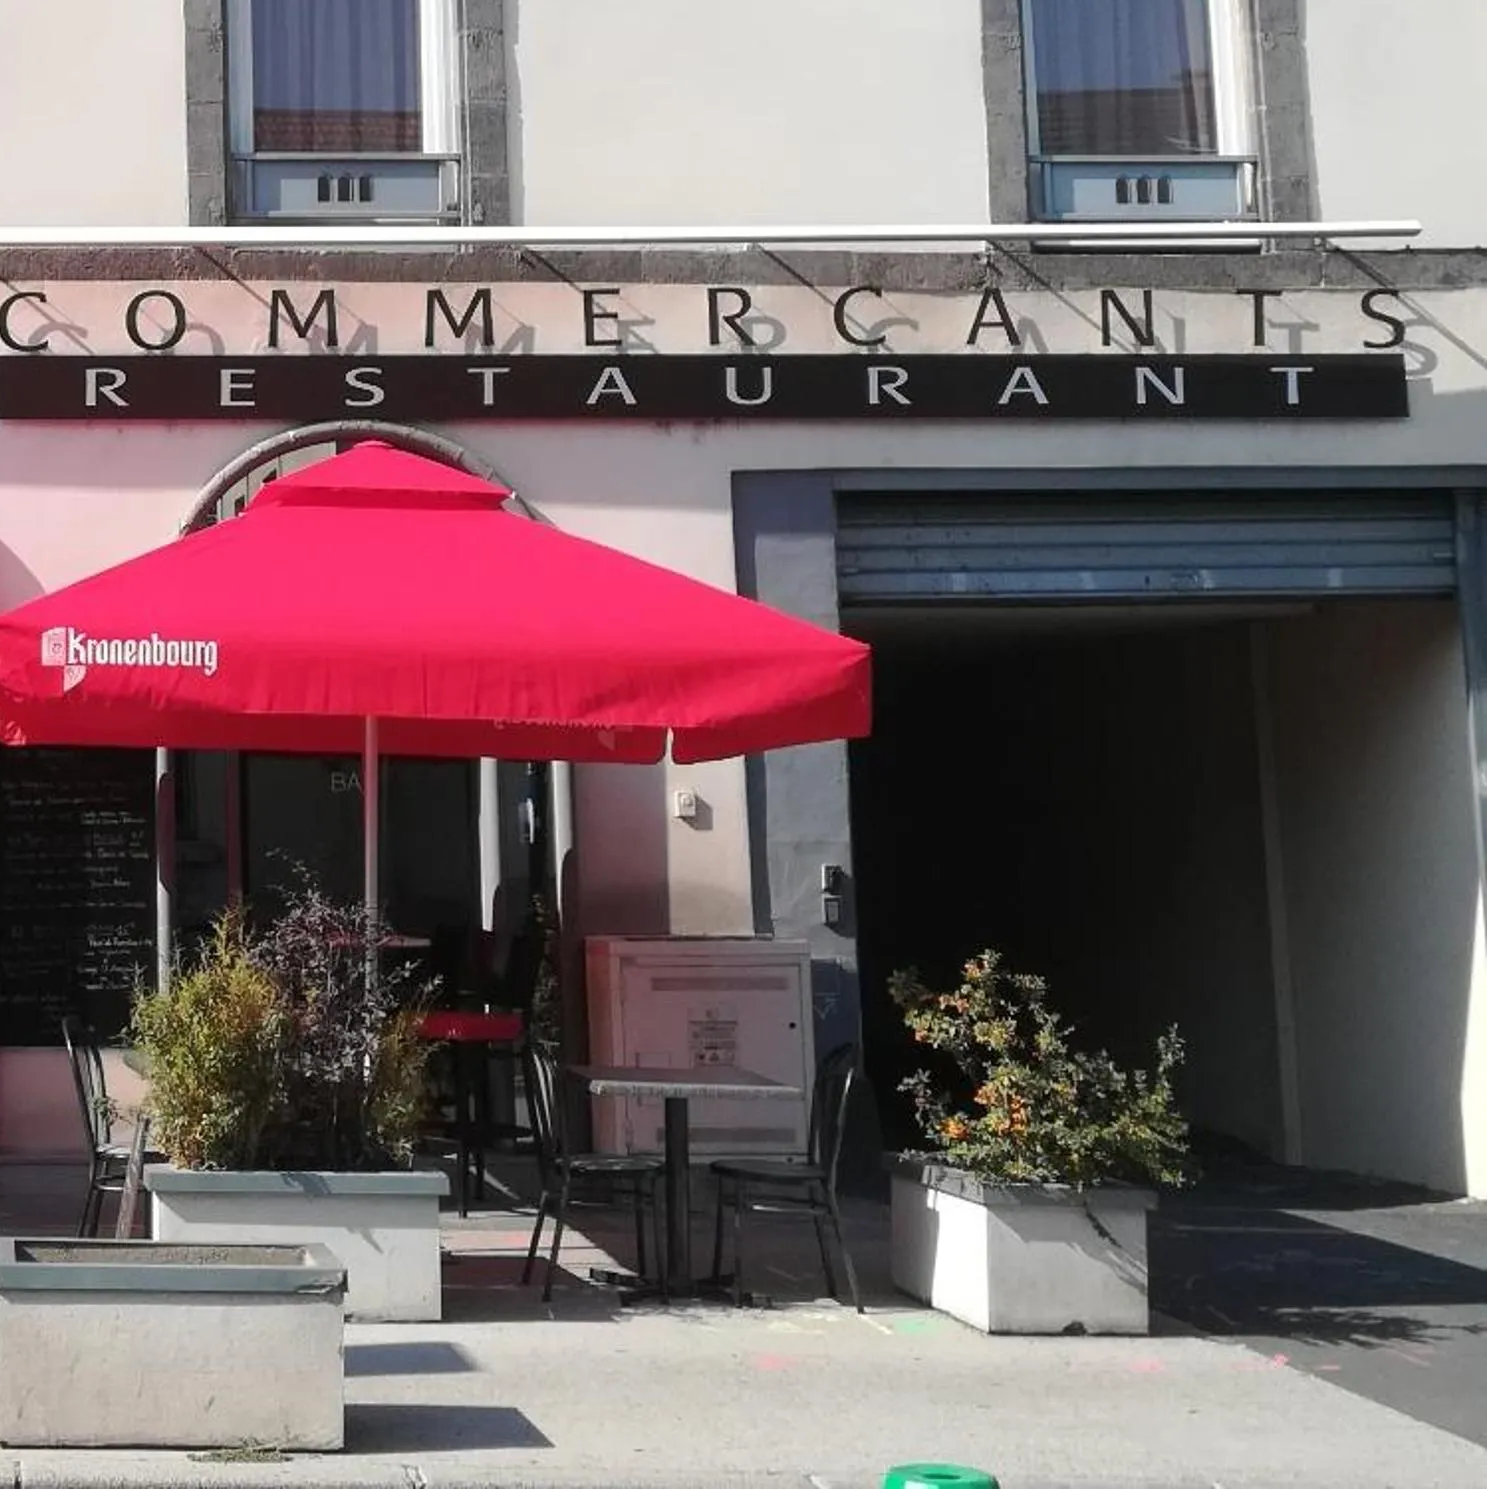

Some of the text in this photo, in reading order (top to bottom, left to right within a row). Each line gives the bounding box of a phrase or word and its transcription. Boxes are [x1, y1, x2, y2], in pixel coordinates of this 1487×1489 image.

[85, 365, 1315, 408] RESTAURANT
[67, 626, 218, 677] Kronenbourg
[330, 769, 365, 794] BA
